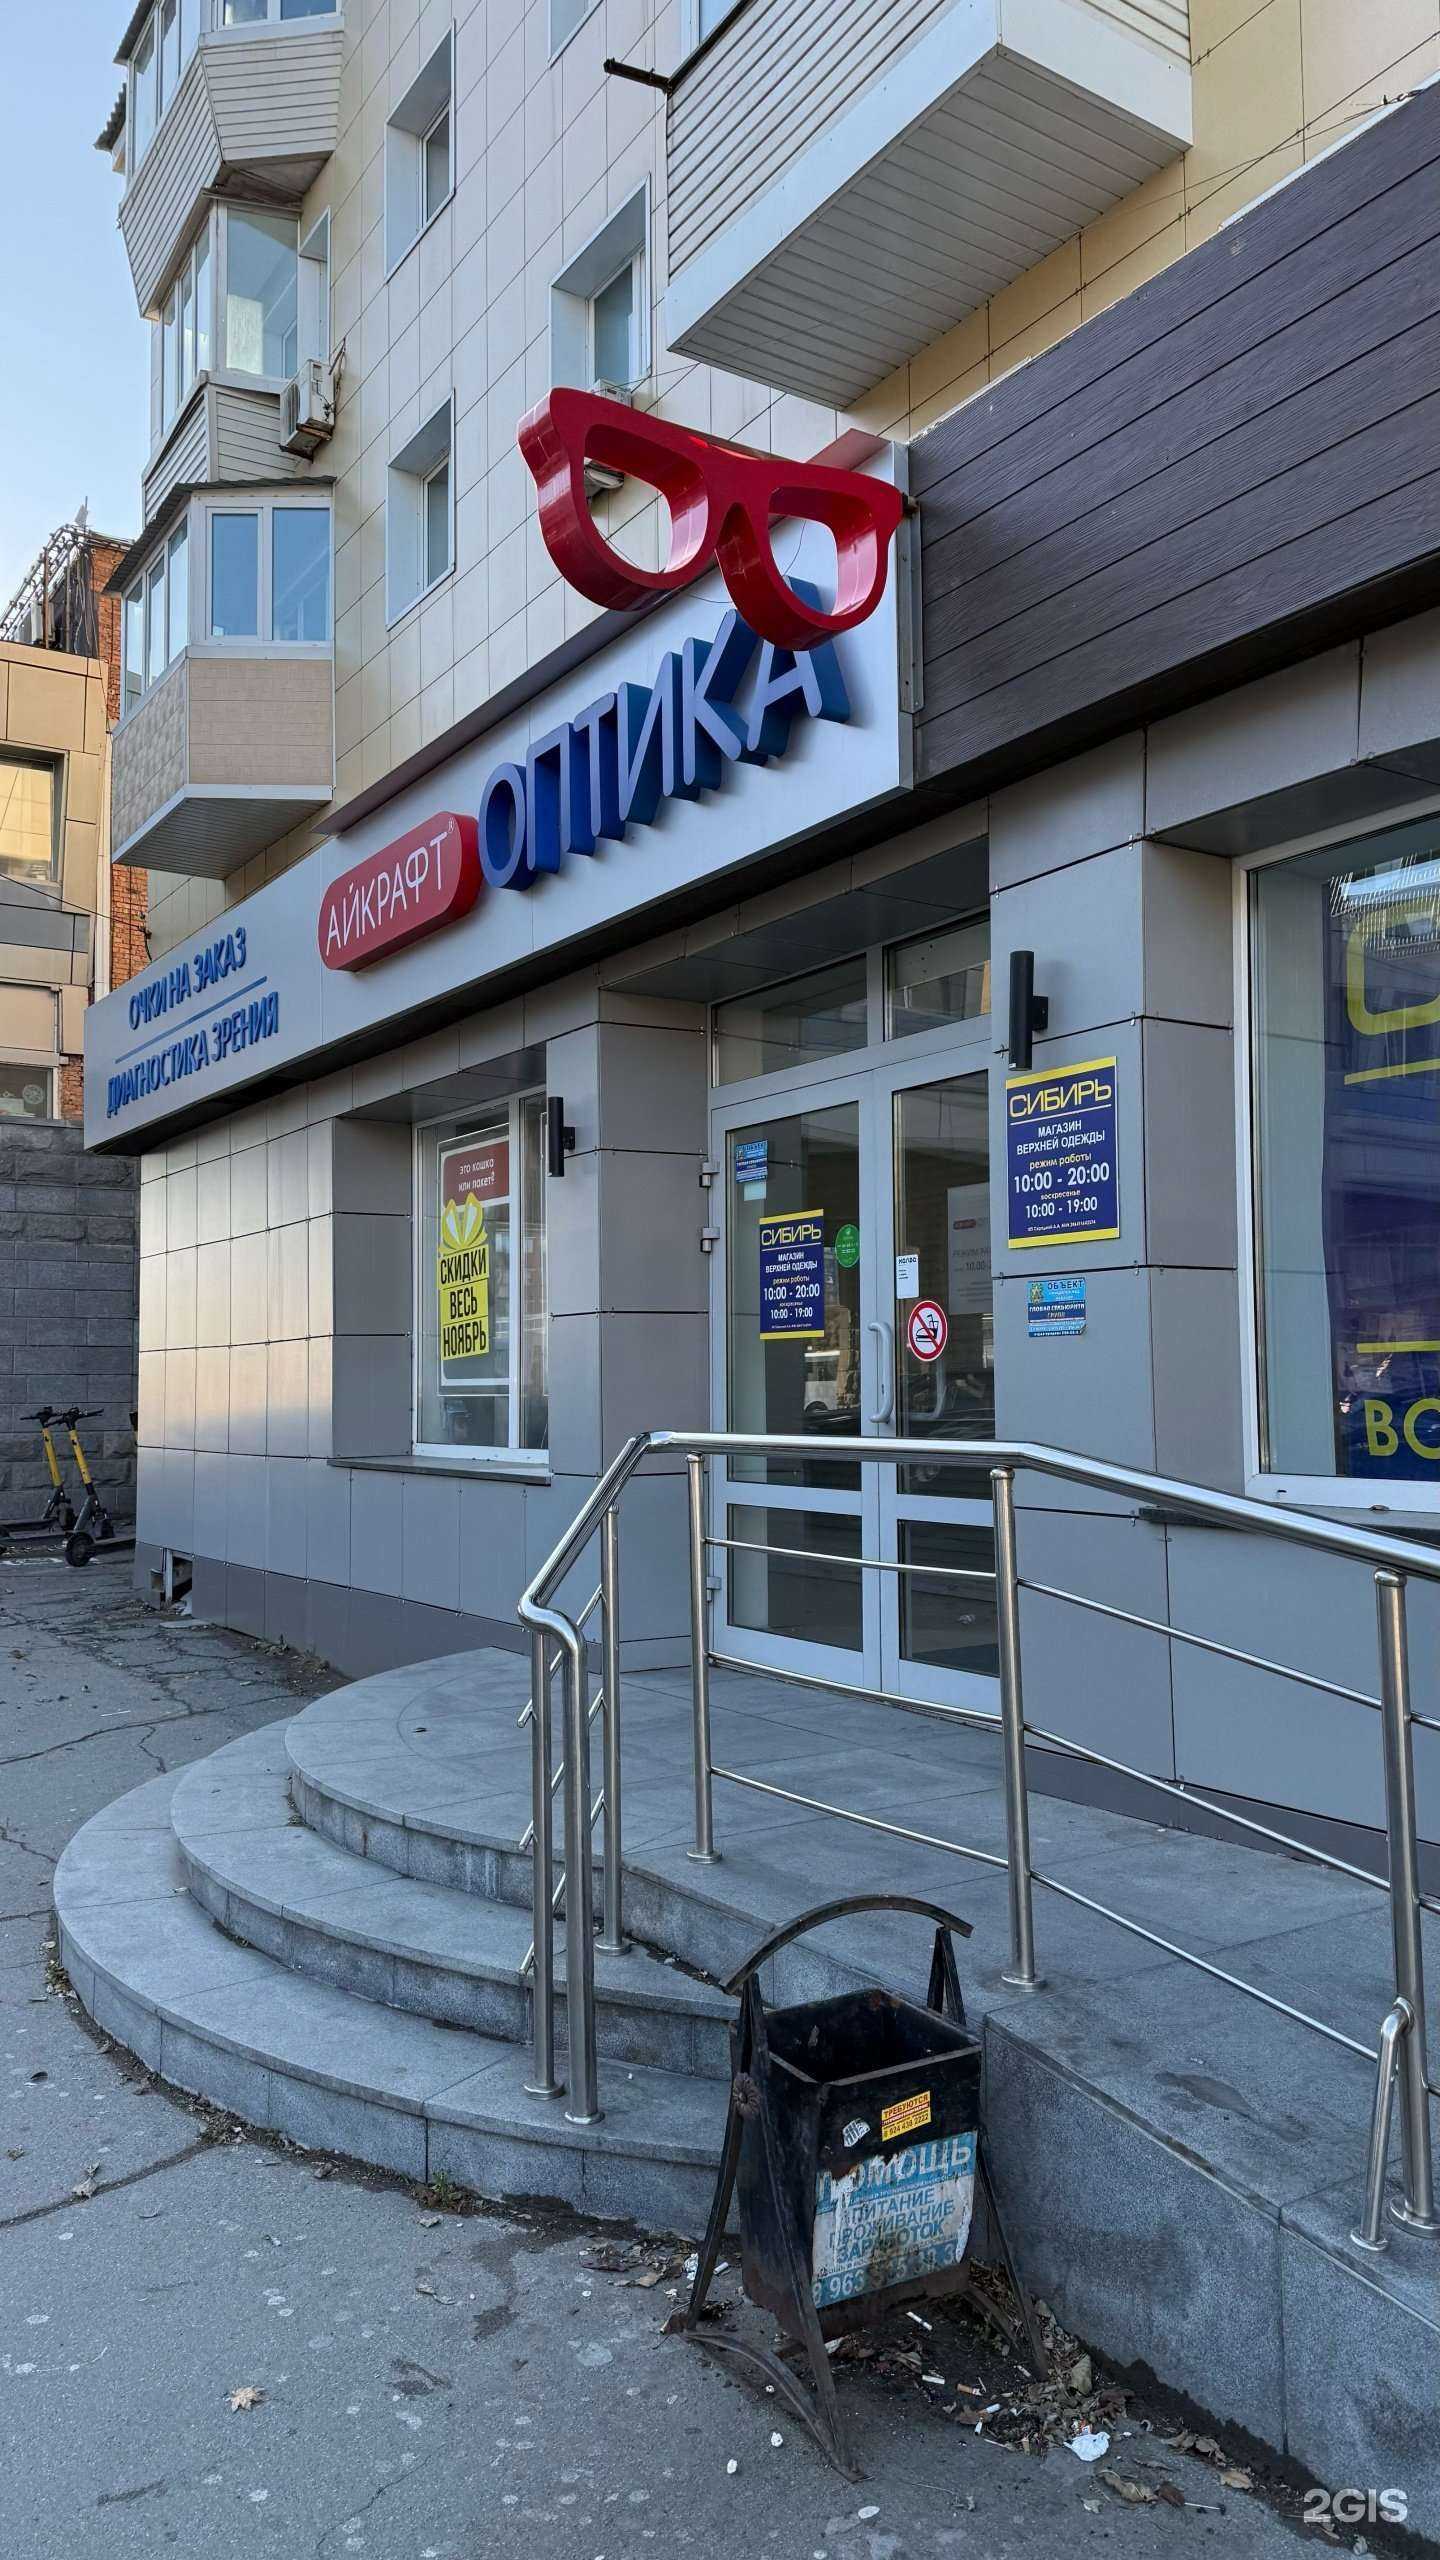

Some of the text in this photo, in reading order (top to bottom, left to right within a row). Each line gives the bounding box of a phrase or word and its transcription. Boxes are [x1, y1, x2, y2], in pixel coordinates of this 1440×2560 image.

[478, 576, 850, 891] ОПТИКА
[129, 926, 247, 1031] ОЧКИ НА ЗАКАЗ
[107, 991, 279, 1119] ДИАГНОСТИКА ЗРЕНИЯ
[1009, 1078, 1112, 1118] СИБИРЬ
[1038, 1119, 1082, 1138] МАГАЗИН
[1016, 1130, 1105, 1156] ВЕРХНЕЙ ОДЕЖДЫ
[1029, 1152, 1092, 1171] режим работы
[1014, 1171, 1052, 1193] 10:00
[1067, 1162, 1110, 1186] 20:00
[1025, 1201, 1055, 1219] 10:00
[1067, 1196, 1098, 1213] 19:00
[761, 1223, 822, 1246] СИБИРЬ
[440, 1247, 487, 1285] СКИДКИ
[765, 1260, 818, 1273] ВЕРХНЕЙ ОДЕЖДЫ
[778, 1251, 804, 1262] МАГАЗИН
[450, 1286, 478, 1320] ВЕСЬ
[763, 1286, 787, 1301] 10:00
[795, 1283, 821, 1298] 20:00
[770, 1308, 789, 1320] 10:00
[795, 1306, 813, 1318] 19:00
[443, 1319, 487, 1357] НОЯБРЬ
[883, 2094, 929, 2119] ТРЕБУЮТСЯ
[852, 2187, 935, 2223] ПИТАНИЕ
